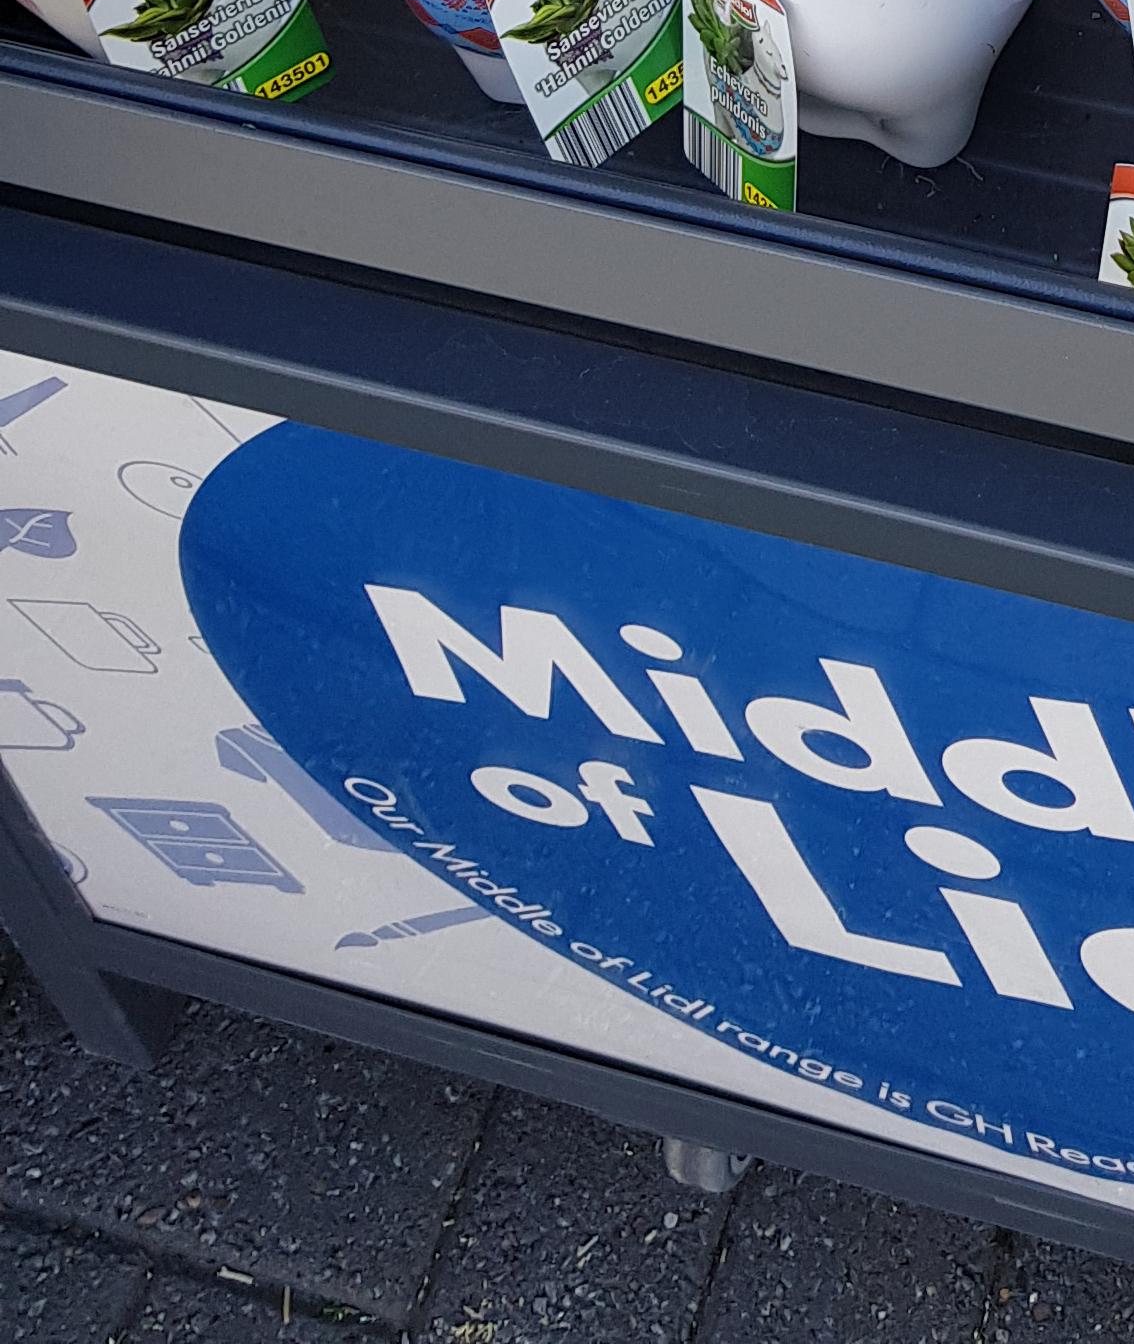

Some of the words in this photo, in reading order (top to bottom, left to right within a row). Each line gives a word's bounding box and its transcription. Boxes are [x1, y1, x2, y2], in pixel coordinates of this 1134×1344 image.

[258, 55, 326, 99] 143501
[648, 63, 683, 99] 1435
[709, 56, 768, 116] Echeveria
[711, 84, 767, 141] pulidonis
[471, 760, 655, 847] of
[344, 777, 424, 835] Our
[414, 839, 563, 938] Middle
[570, 942, 628, 972] of
[626, 971, 717, 1020] Lidl
[716, 1018, 863, 1091] range
[878, 1081, 911, 1109] is
[926, 1100, 1014, 1143] GH
